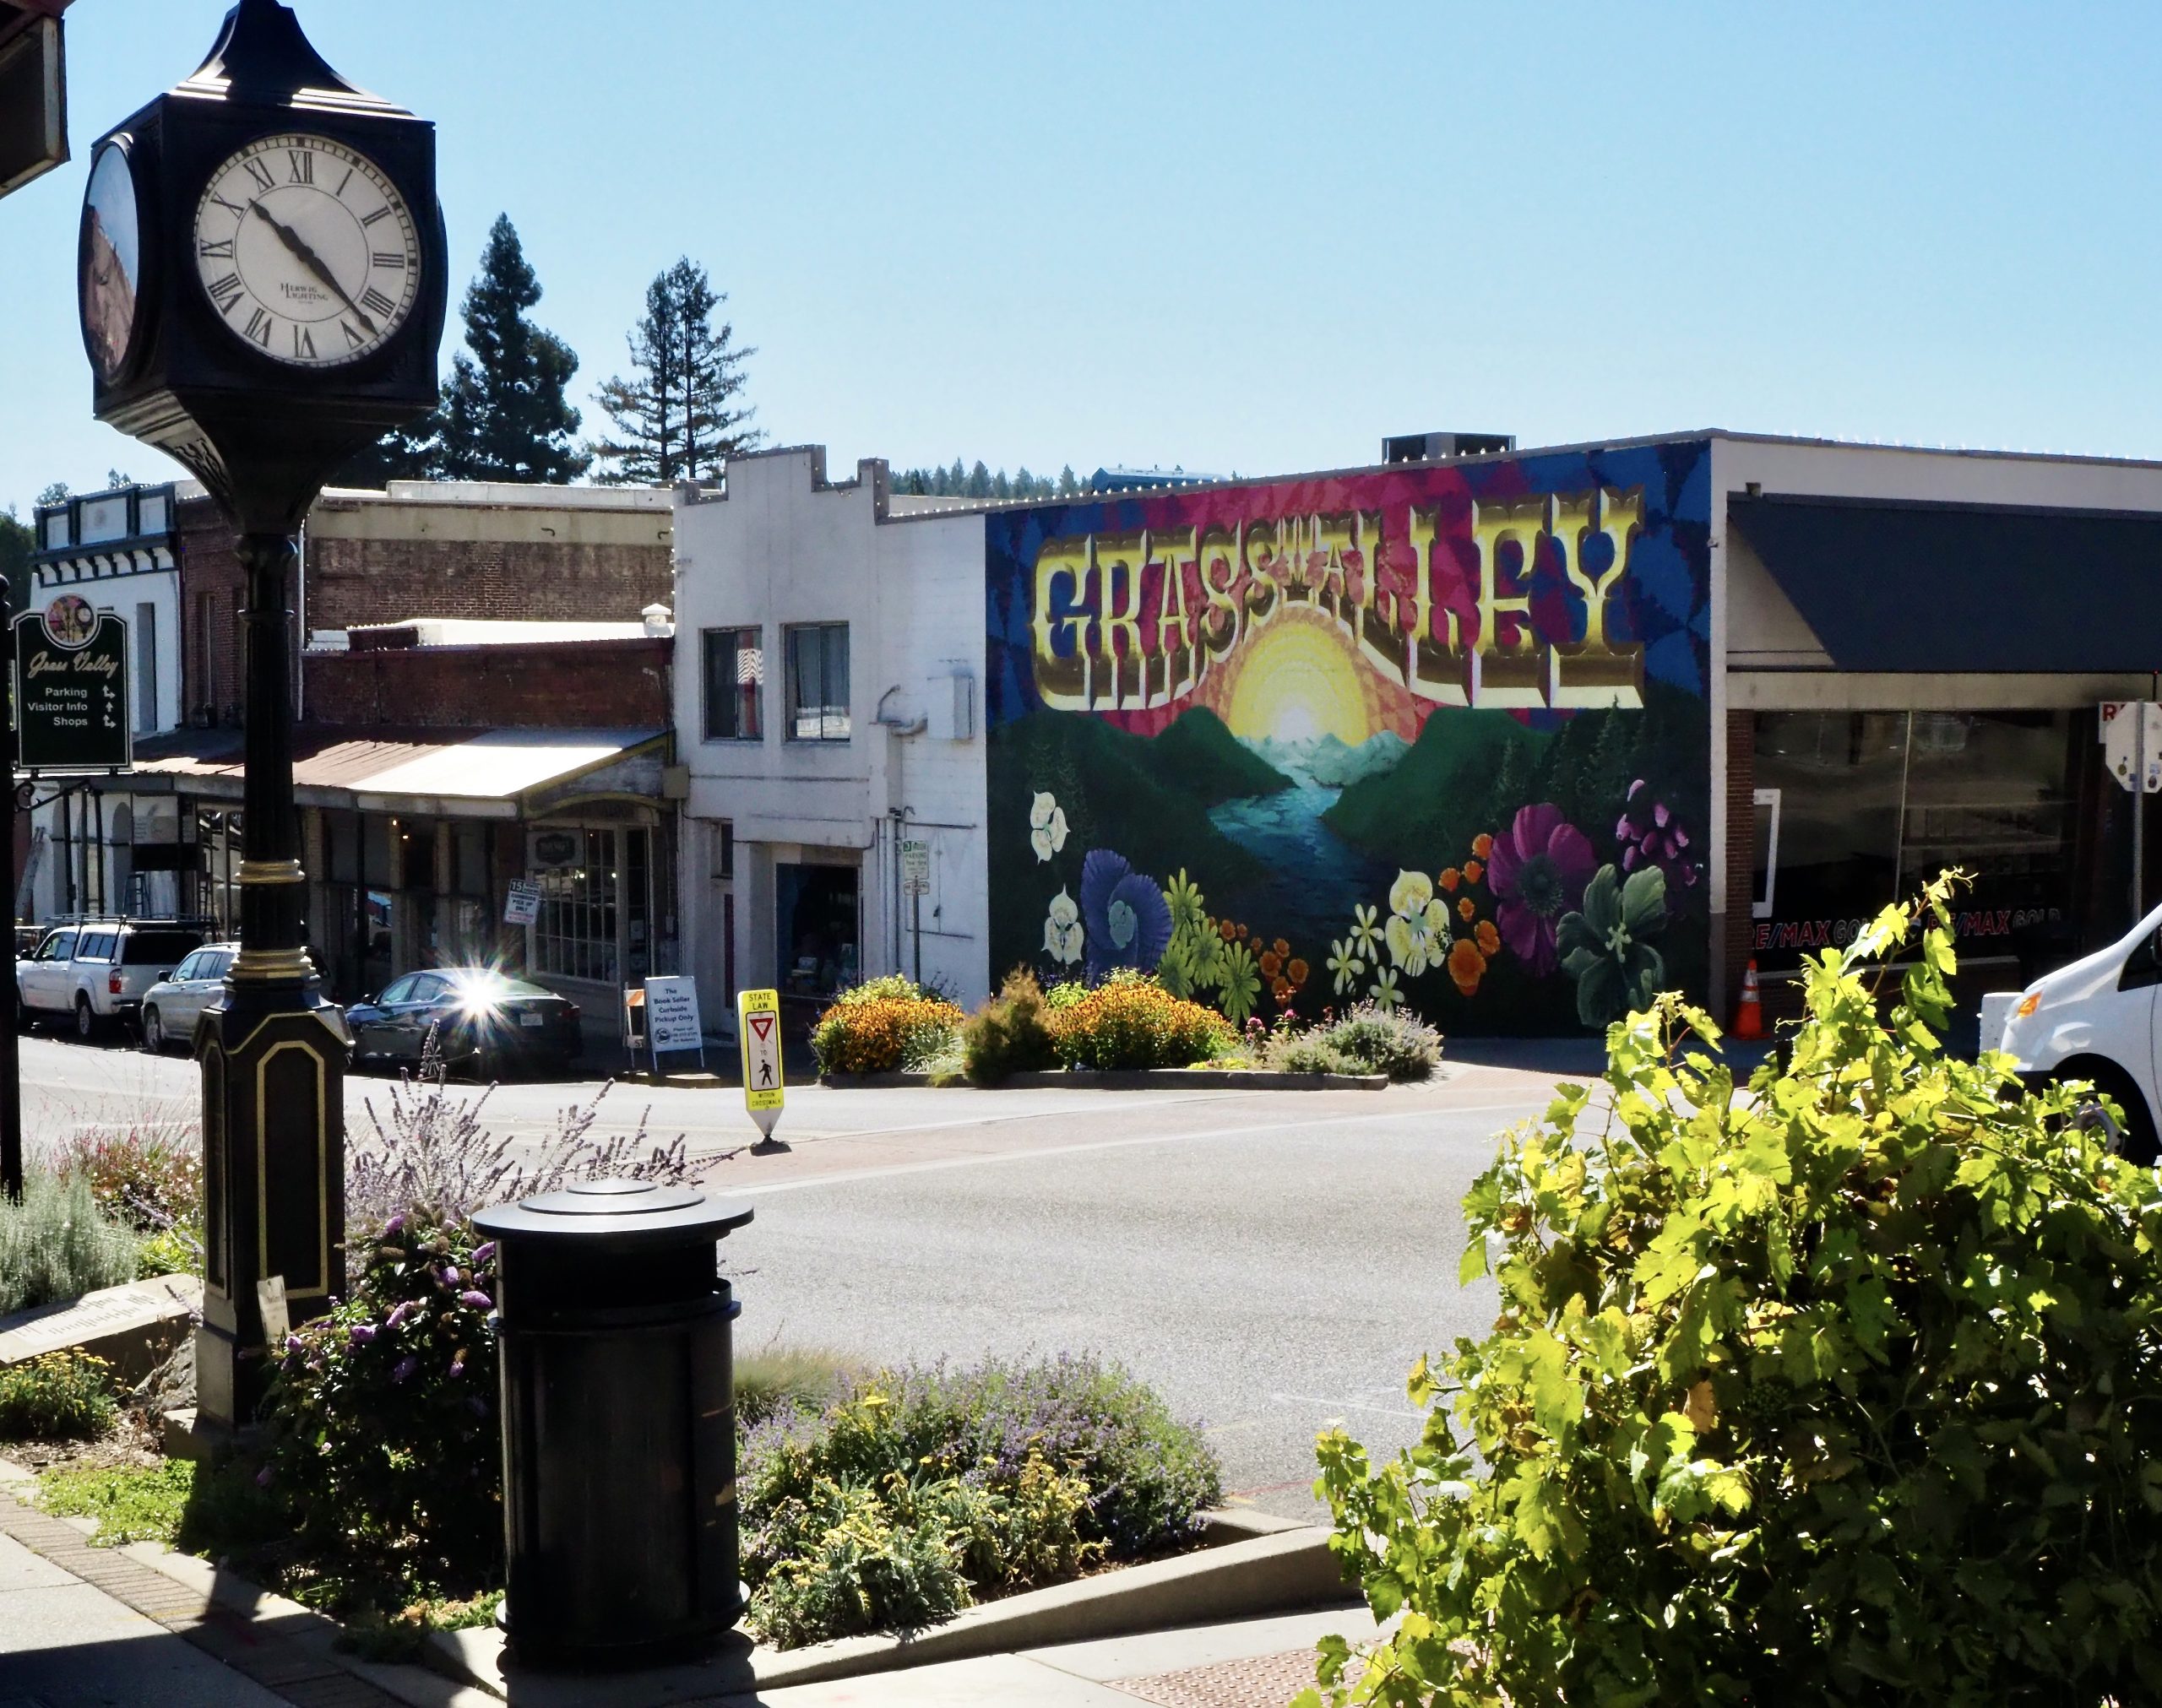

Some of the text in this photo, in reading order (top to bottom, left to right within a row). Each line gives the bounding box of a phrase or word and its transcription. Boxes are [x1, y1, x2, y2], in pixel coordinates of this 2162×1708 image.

[243, 156, 275, 193] XI
[288, 149, 314, 184] XII
[210, 192, 244, 220] X
[361, 205, 392, 229] II
[372, 252, 405, 269] III
[1033, 484, 1643, 711] GRASS VALLEY
[28, 651, 119, 679] Grass Valley
[45, 687, 88, 698] Parking
[28, 702, 88, 711] Visitor Info
[53, 717, 88, 727] Shops
[511, 881, 522, 892] 15
[1752, 919, 1831, 950] E/MAX
[748, 993, 772, 1001] STATE
